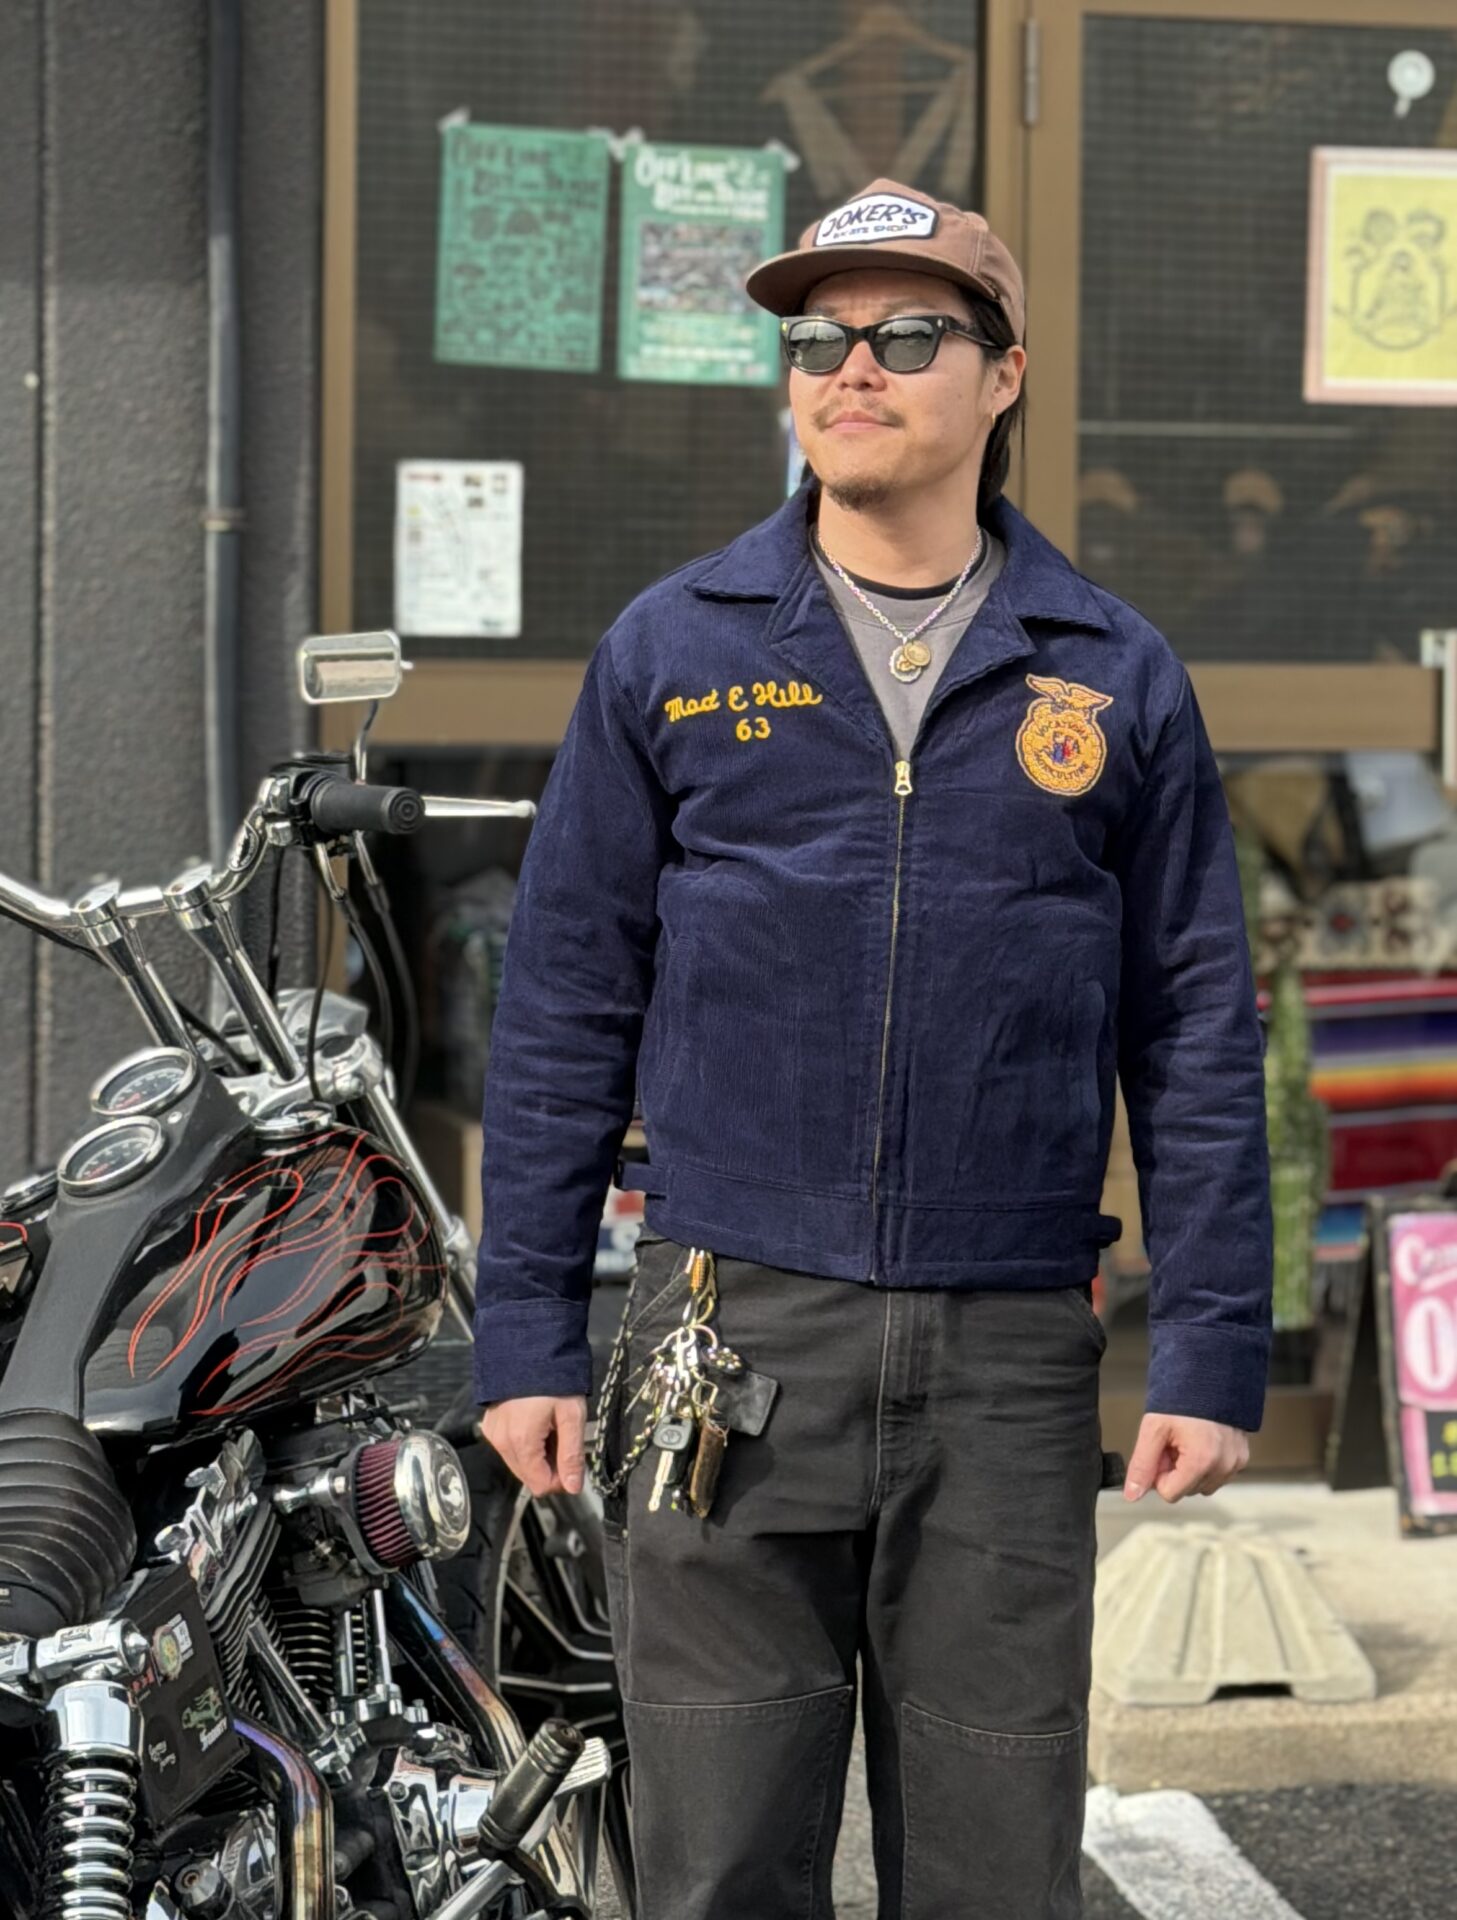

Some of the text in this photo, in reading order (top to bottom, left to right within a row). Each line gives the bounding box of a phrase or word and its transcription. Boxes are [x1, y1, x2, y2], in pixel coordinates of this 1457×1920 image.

[822, 203, 929, 237] JOKER'S
[753, 680, 823, 708] Hill
[735, 716, 772, 742] 63
